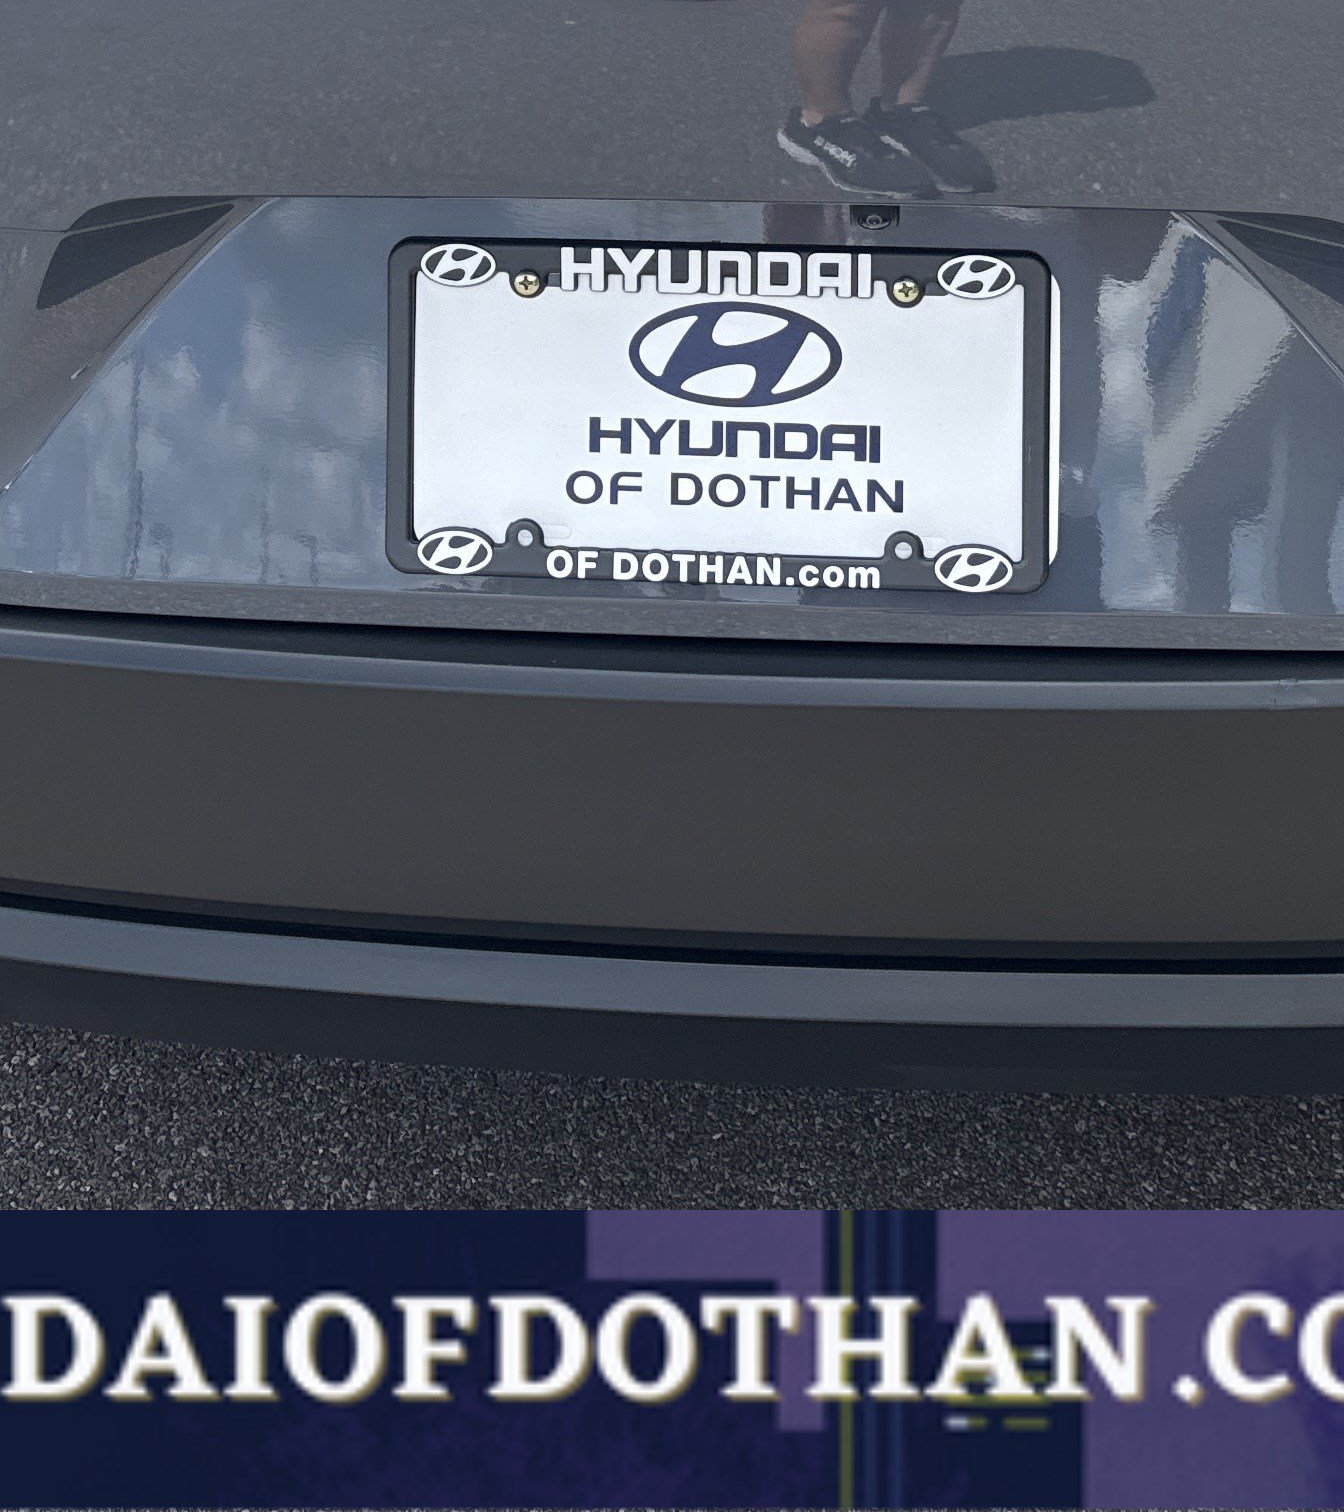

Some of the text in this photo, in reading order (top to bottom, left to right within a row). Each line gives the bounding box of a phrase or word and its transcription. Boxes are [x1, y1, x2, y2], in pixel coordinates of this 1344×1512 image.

[560, 246, 872, 299] HYUNDAI
[587, 416, 882, 464] HYUNDAI
[564, 470, 904, 514] OF DOTHAN
[545, 548, 881, 589] OF DOTHAN.com
